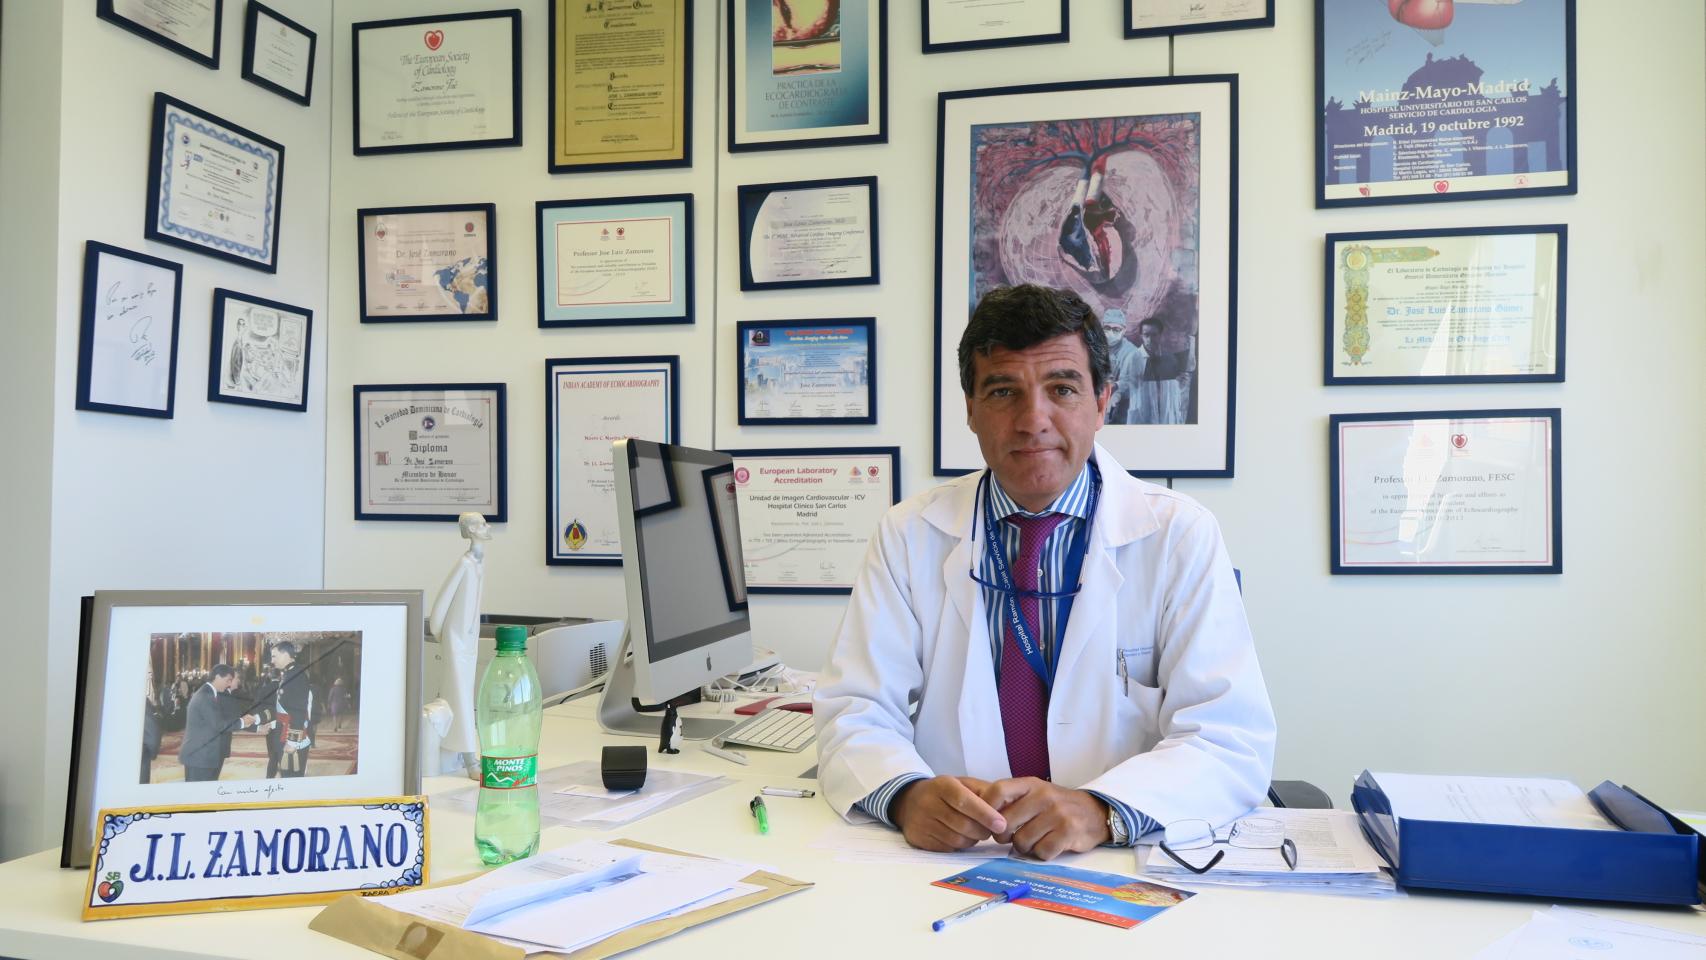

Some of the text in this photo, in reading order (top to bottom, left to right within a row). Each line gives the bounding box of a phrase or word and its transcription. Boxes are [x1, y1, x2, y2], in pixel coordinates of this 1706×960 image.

[1358, 79, 1530, 104] Mainz-Mayo-Madrid
[1360, 104, 1399, 114] HOSPITAL
[1400, 101, 1462, 112] UNIVERSITARIO
[1494, 96, 1527, 105] CARLOS
[1388, 111, 1424, 120] SERVICIO
[1364, 116, 1524, 137] Madrid, 19 octubre 1992
[410, 443, 448, 454] Diploma
[760, 467, 837, 477] European Laboratory
[1488, 473, 1516, 481] FESC
[990, 544, 1006, 570] Servicio
[1000, 570, 1011, 590] Cajal
[1014, 625, 1034, 655] Hospital
[129, 822, 409, 883] J.L. ZAMORANO
[1056, 888, 1080, 897] daily
